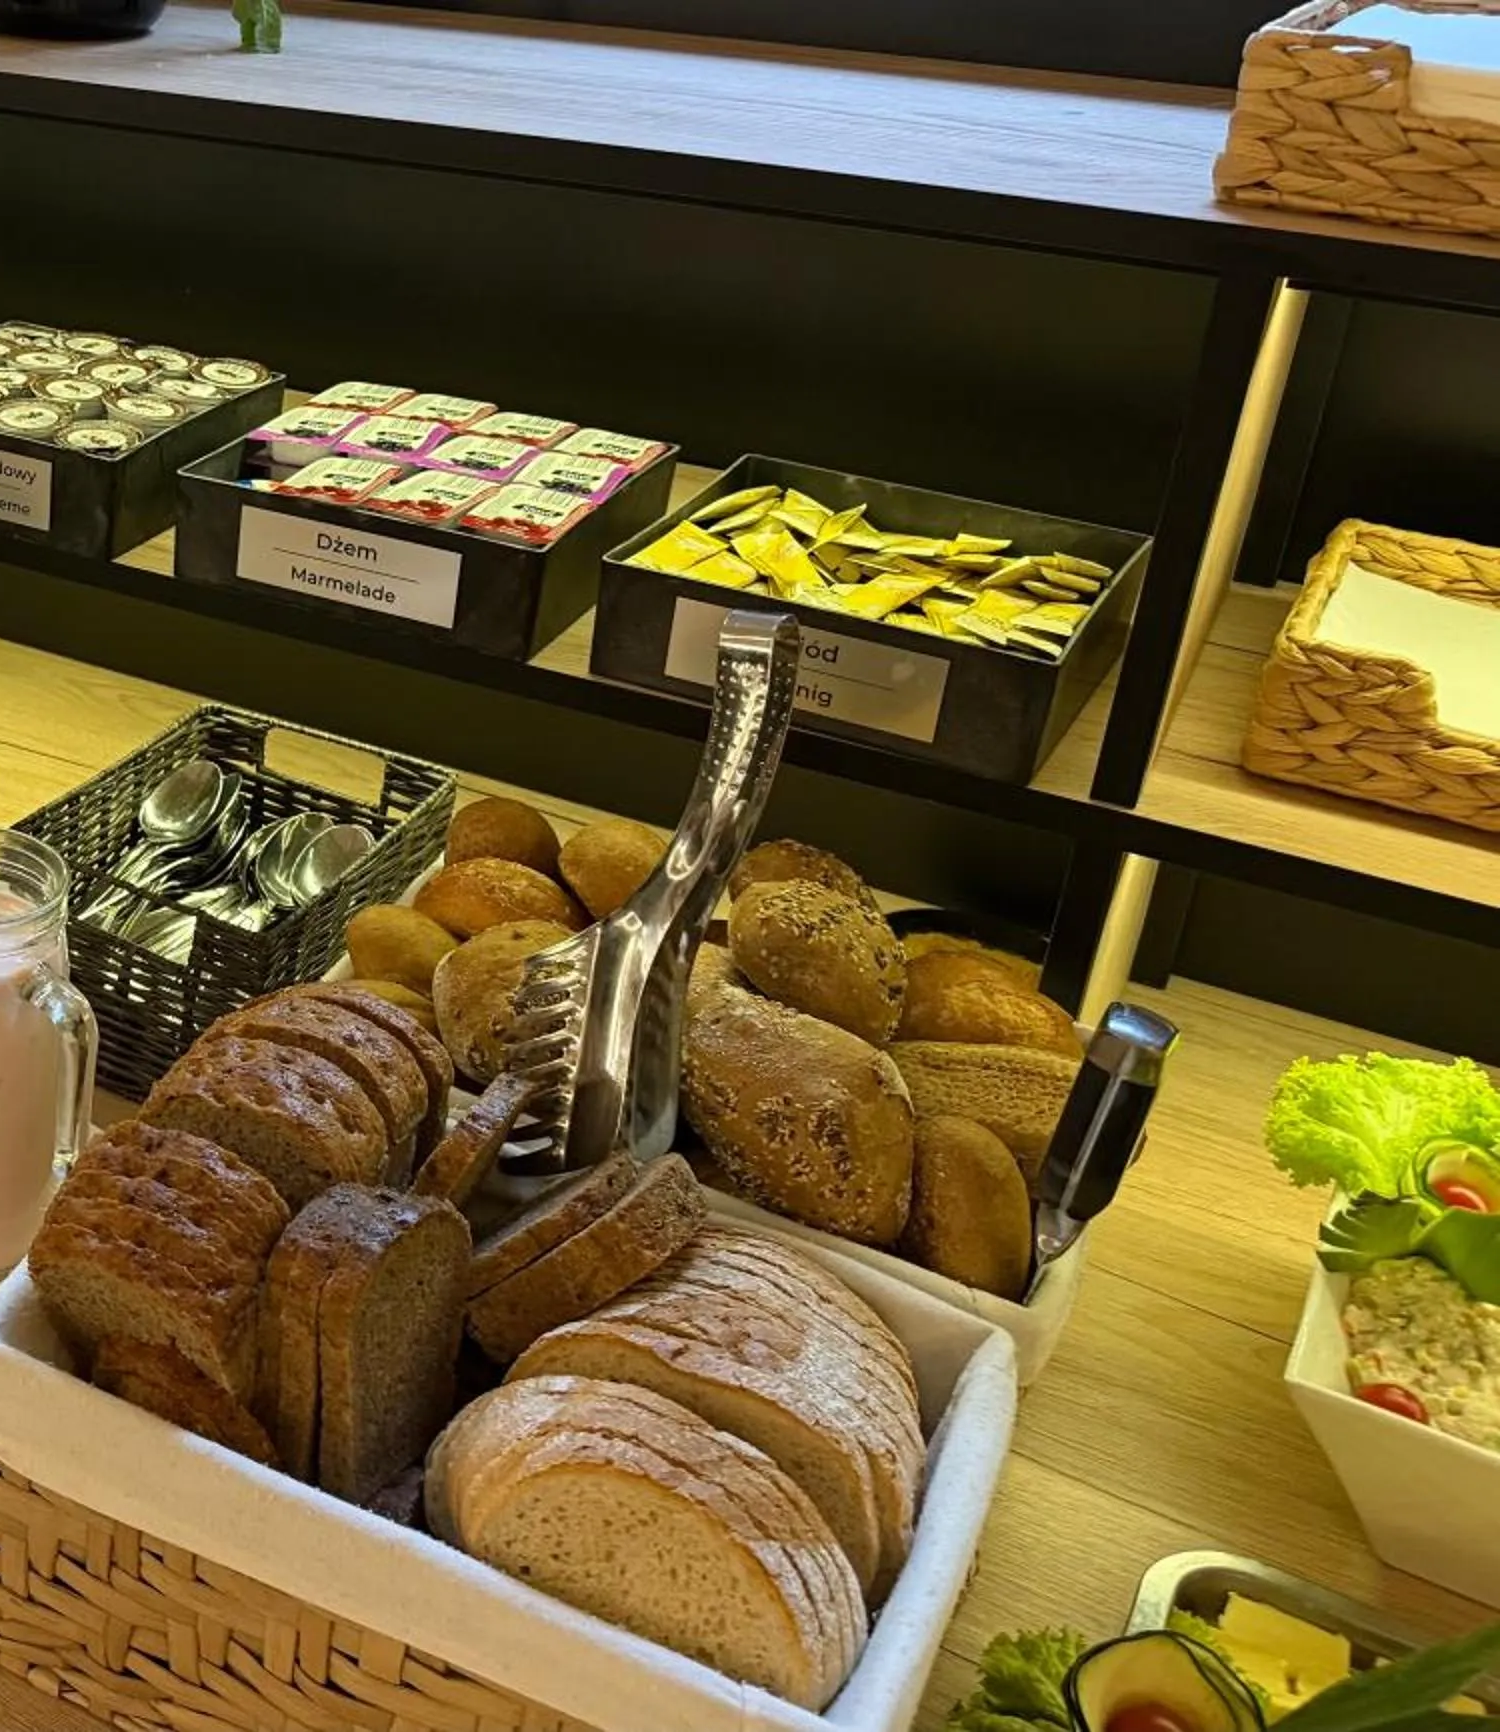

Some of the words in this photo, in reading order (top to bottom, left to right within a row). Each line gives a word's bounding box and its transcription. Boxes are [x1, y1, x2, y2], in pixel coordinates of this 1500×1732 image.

[317, 533, 377, 561] Dżem
[291, 565, 396, 603] Marmelade
[796, 683, 832, 707] nig
